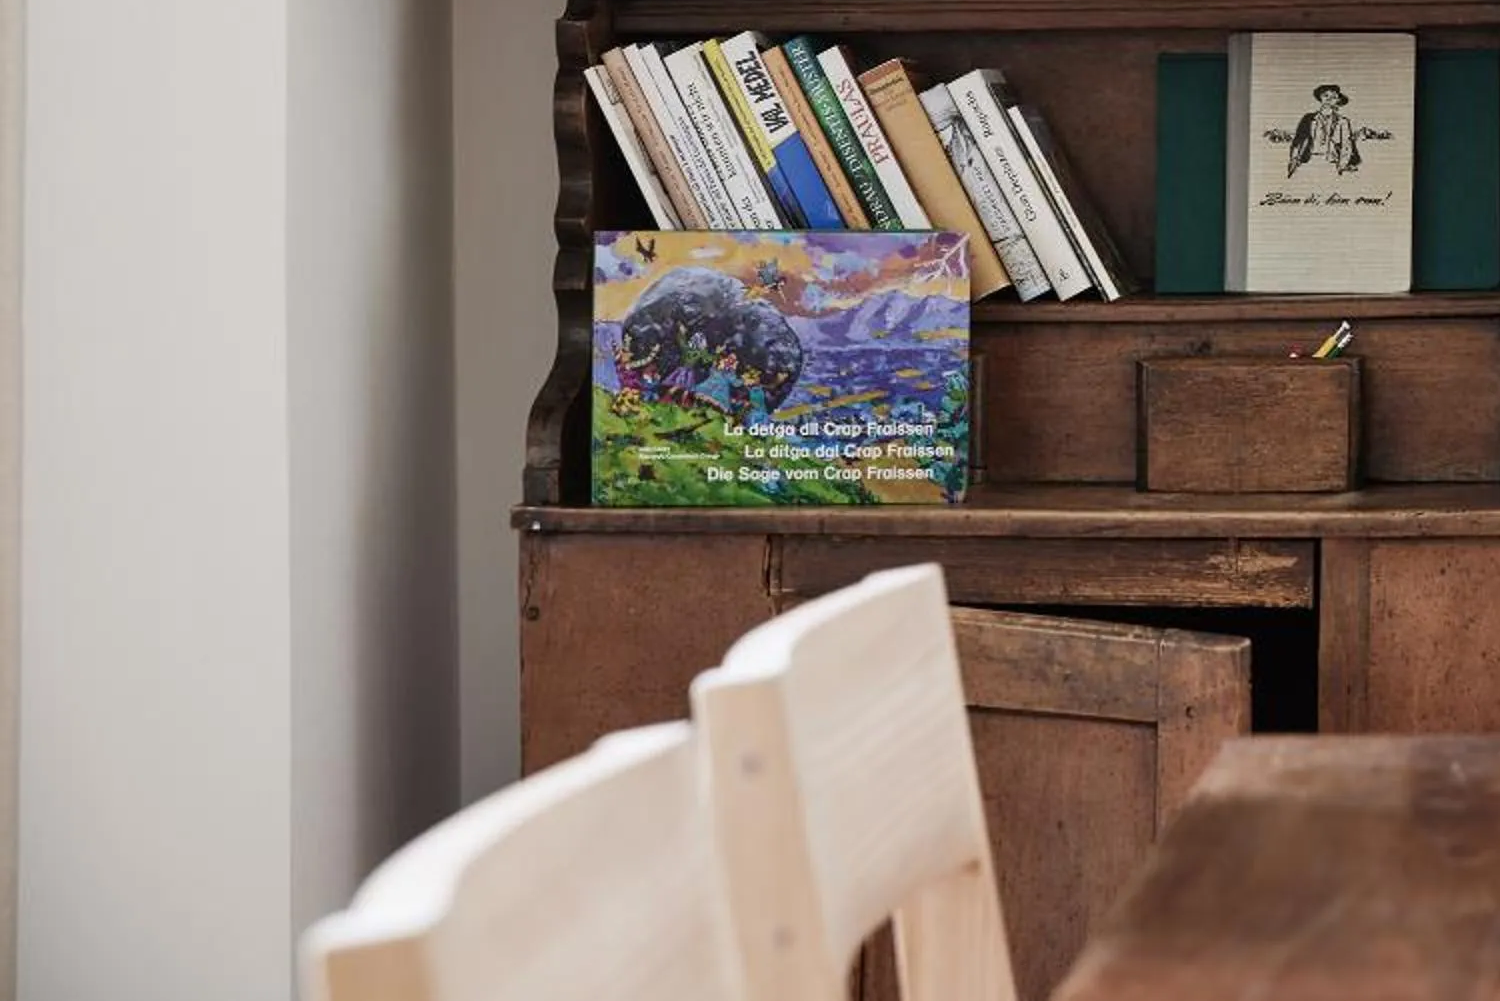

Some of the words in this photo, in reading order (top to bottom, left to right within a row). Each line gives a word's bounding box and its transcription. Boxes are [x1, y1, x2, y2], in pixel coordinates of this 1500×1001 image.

[732, 49, 776, 104] MEDEL
[757, 100, 790, 135] VAL
[833, 76, 891, 166] PRAULAS
[723, 423, 743, 437] La
[749, 423, 796, 439] detga
[800, 423, 818, 436] dil
[823, 423, 862, 438] Crap
[867, 423, 934, 437] Fraissen
[745, 445, 764, 459] La
[769, 445, 810, 460] ditga
[815, 445, 839, 458] dal
[843, 445, 882, 459] Crap
[887, 445, 954, 458] Fraissen
[707, 467, 733, 481] Die
[738, 467, 781, 482] Sage
[785, 469, 819, 480] vom
[823, 467, 862, 481] Crap
[867, 466, 934, 480] Fraissen
